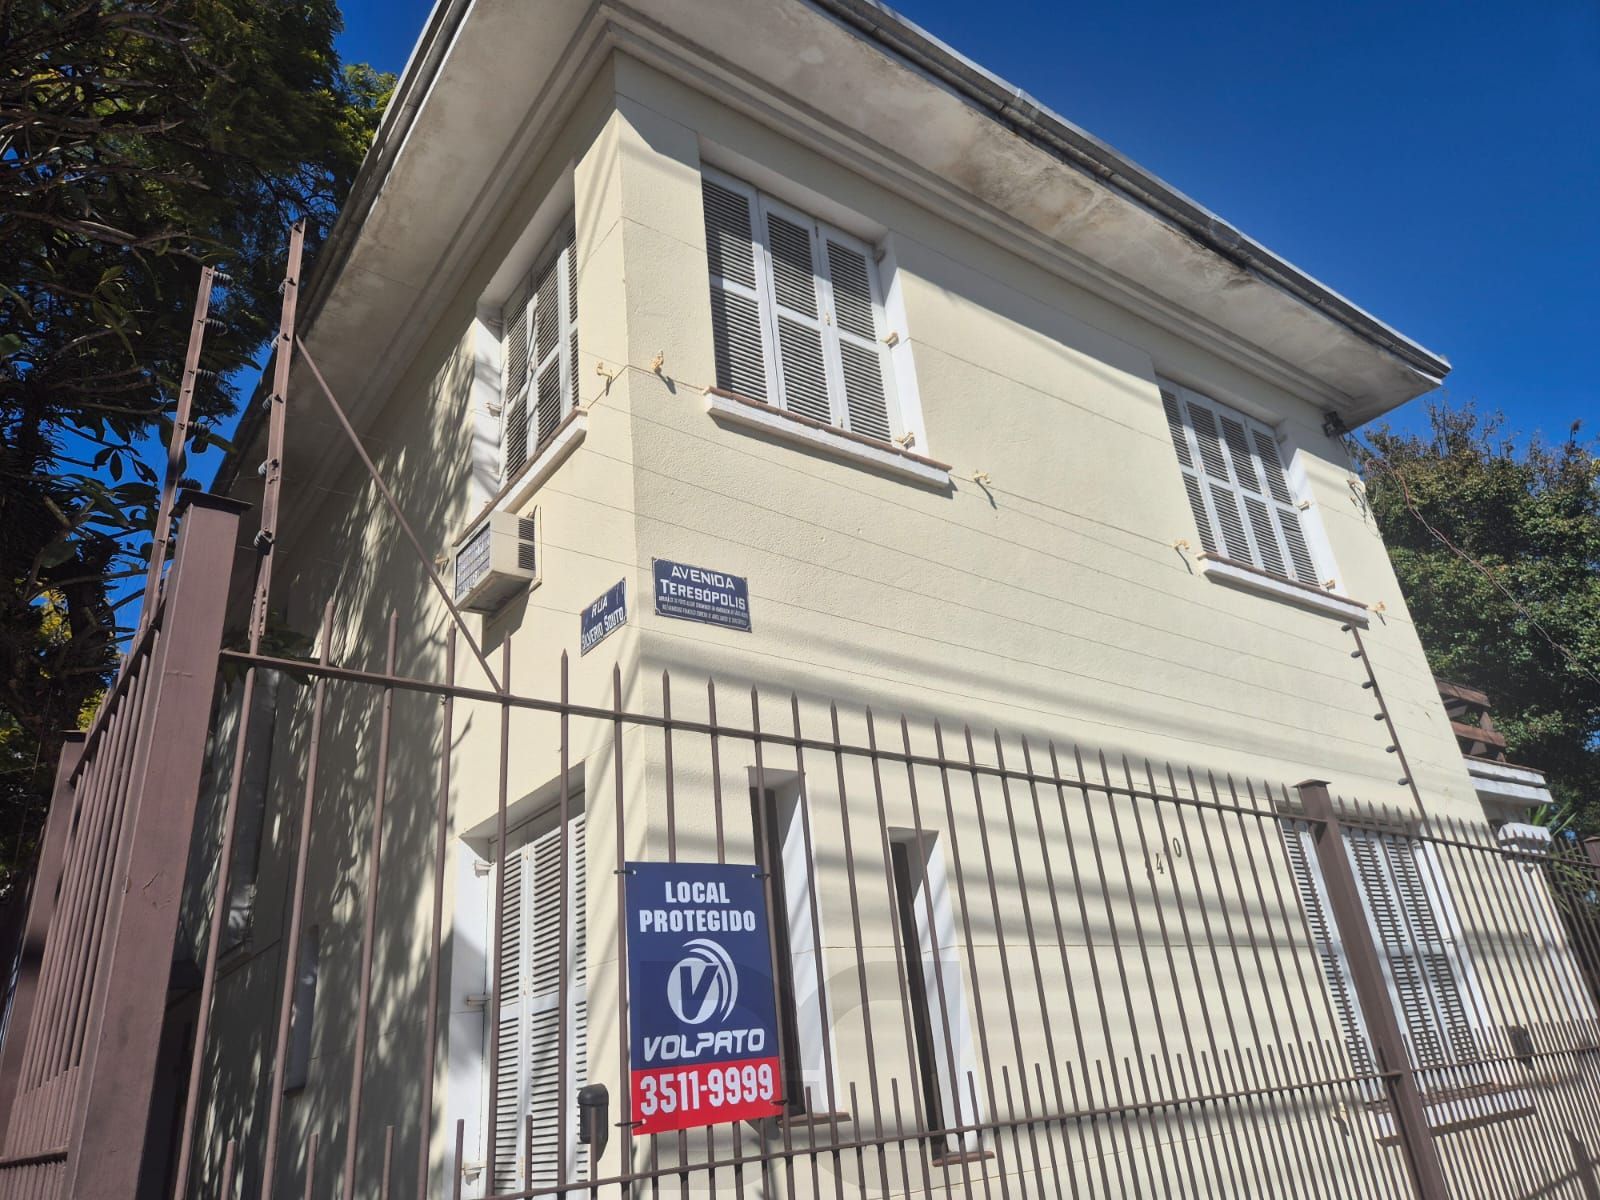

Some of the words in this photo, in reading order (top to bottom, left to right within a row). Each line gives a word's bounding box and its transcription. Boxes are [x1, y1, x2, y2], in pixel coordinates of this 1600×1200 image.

[671, 565, 736, 590] AVENIDA
[591, 595, 608, 618] RUA
[660, 578, 746, 610] TERESÓPOLIS
[603, 606, 624, 632] SOUTO
[665, 881, 730, 904] LOCAL
[639, 909, 756, 932] PROTEGIDO
[643, 1028, 765, 1062] VOLPATO
[640, 1063, 774, 1117] 3511-9999
